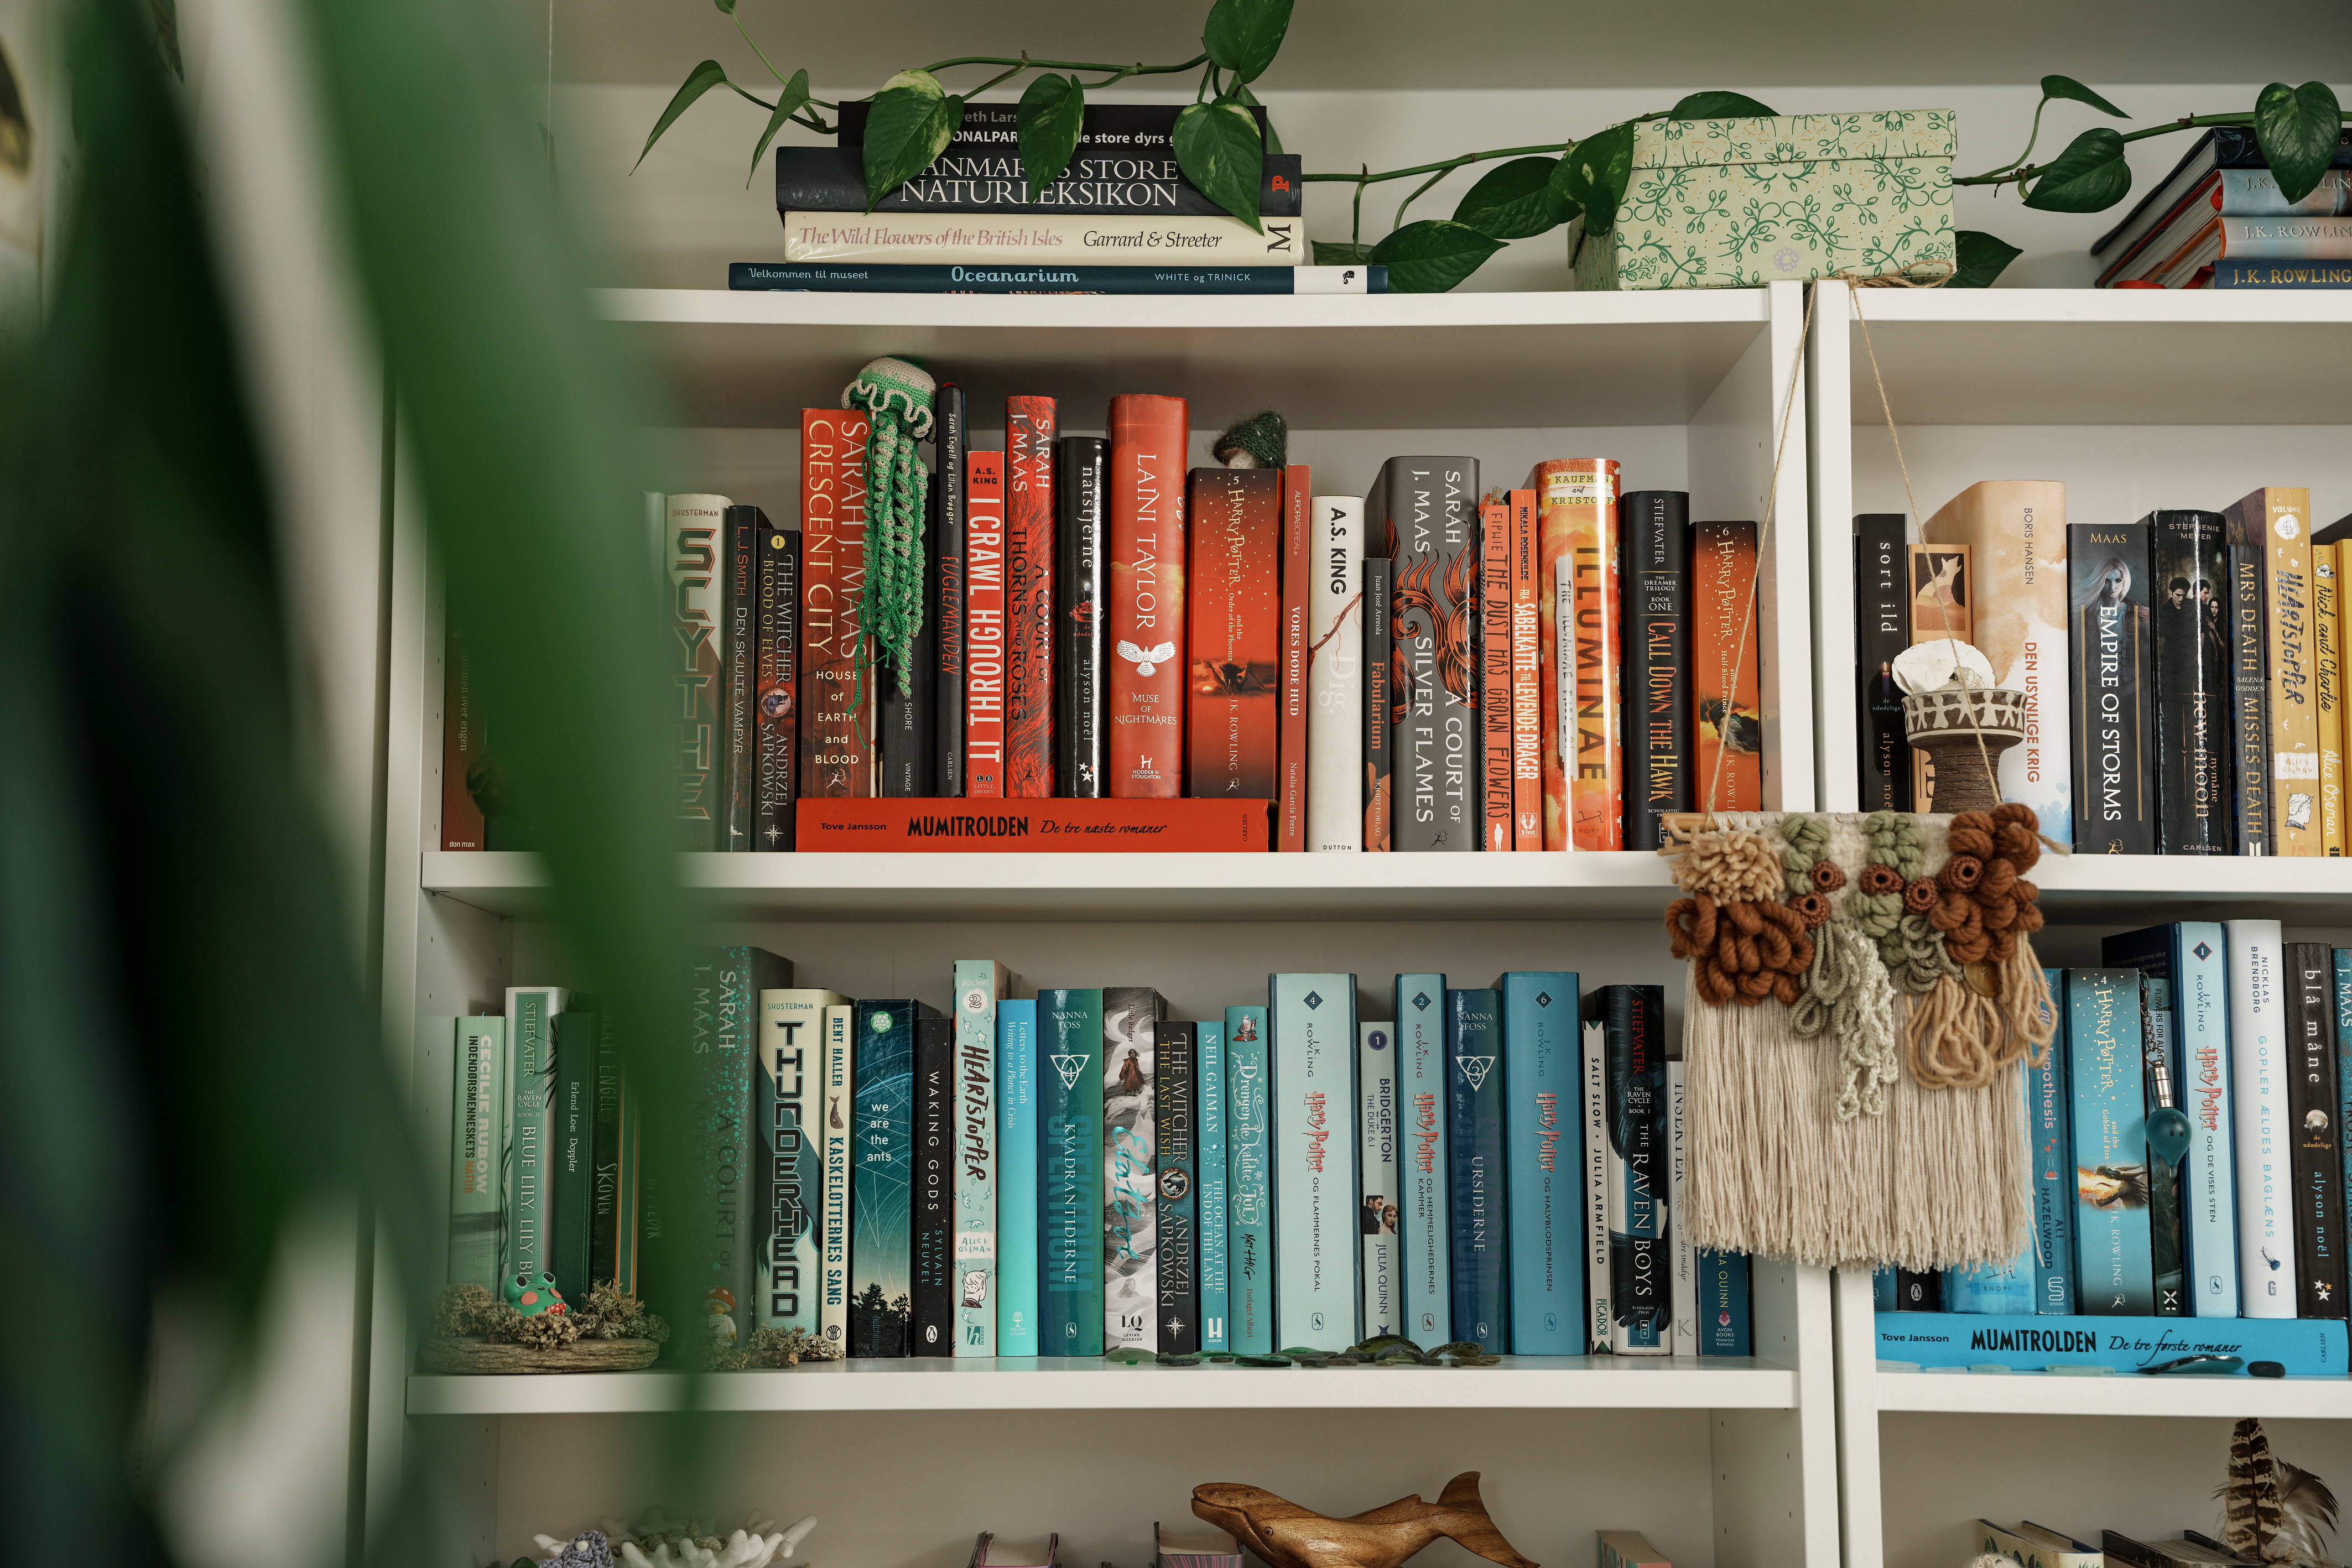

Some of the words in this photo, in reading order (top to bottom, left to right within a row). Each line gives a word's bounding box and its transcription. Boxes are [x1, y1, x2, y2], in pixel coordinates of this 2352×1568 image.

[1095, 133, 1130, 143] store
[1135, 132, 1164, 146] dyrs
[1080, 160, 1178, 180] STORE
[799, 227, 830, 244] The
[831, 228, 869, 244] Wild
[875, 228, 932, 246] Flowers
[935, 228, 951, 248] of
[953, 228, 974, 246] the
[977, 229, 1027, 246] British
[1031, 230, 1062, 246] Isles
[1084, 231, 1143, 248] Garrard
[1147, 231, 1162, 247] &
[1165, 231, 1222, 247] Streeter
[748, 267, 812, 278] Velkommen
[815, 269, 826, 278] til
[830, 270, 868, 279] museet
[951, 266, 1079, 283] Oceanarium
[1194, 275, 1205, 283] og
[2233, 269, 2265, 285] J.K.
[2270, 269, 2351, 284] ROWLING
[947, 413, 956, 434] Sarah
[945, 436, 956, 459] Engell
[946, 462, 955, 471] og
[947, 473, 956, 492] Lilian
[807, 420, 834, 576] CRESCENT
[1136, 453, 1159, 523] LAINI
[945, 494, 955, 525] Brøgger
[1330, 507, 1347, 542] A.S.
[2023, 507, 2033, 538] BORIS
[736, 540, 748, 551] J.
[737, 526, 748, 539] L.
[1653, 498, 1665, 565] STIEFVATER
[2090, 533, 2127, 543] MAAS
[969, 515, 1001, 596] CRAWL
[1011, 527, 1028, 616] THORNS
[1035, 564, 1049, 581] A
[1330, 548, 1347, 595] KING
[1486, 555, 1508, 589] THE
[1879, 543, 1895, 589] sort
[2024, 541, 2034, 585] HANSEN
[736, 555, 747, 596] SMITH
[1131, 533, 1157, 631] TAYLOR
[1374, 575, 1382, 592] Juan
[2240, 562, 2255, 602] MRS
[1375, 593, 1383, 608] José
[1519, 590, 1529, 600] FRA
[736, 607, 747, 635] DEN
[807, 581, 834, 655] CITY
[941, 555, 960, 675] FUGLEMANDEN
[1034, 589, 1050, 664] COURT
[1289, 606, 1301, 647] VORES
[1486, 600, 1508, 639] DUST
[1880, 603, 1897, 632] ild
[1015, 620, 1024, 646] AND
[1513, 603, 1537, 671] SABELKATTE
[1648, 622, 1676, 660] CALL
[2099, 605, 2118, 687] EMPIRE
[2241, 609, 2257, 671] DEATH
[735, 641, 746, 696] SKJULTE
[970, 608, 1002, 726] THROUGH
[1288, 649, 1302, 686] DØDE
[1487, 649, 1508, 675] HAS
[2025, 642, 2037, 670] DEN
[1011, 650, 1028, 721] ROSES
[1038, 668, 1049, 684] OF
[1414, 636, 1433, 716] SILVER
[1520, 673, 1529, 681] TIL
[1648, 666, 1677, 713] DOWN
[1132, 692, 1160, 704] MUSE
[1289, 689, 1300, 717] HUD
[1370, 660, 1386, 751] Fabularium
[1445, 692, 1461, 708] A
[1487, 688, 1508, 733] GROWN
[1514, 682, 1538, 731] LEVENDE
[2025, 676, 2039, 744] USYNLIGE
[2101, 693, 2119, 723] OF
[733, 701, 745, 754] VAMPYR
[1115, 715, 1177, 725] NIGHTMARES
[1648, 720, 1674, 749] THE
[2243, 697, 2260, 764] MISSES
[969, 741, 1001, 763] IT
[1445, 717, 1463, 801] COURT
[1516, 733, 1539, 779] DRAGER
[2027, 748, 2039, 783] KRIG
[1289, 762, 1298, 789] Natalia
[1415, 727, 1433, 823] FLAMES
[1487, 747, 1509, 819] FLOWERS
[1648, 754, 1679, 802] HAWK
[2101, 729, 2121, 821] STORMS
[1287, 790, 1298, 814] García
[1450, 806, 1460, 824] OF
[2246, 771, 2262, 835] DEATH
[847, 822, 887, 831] Jansson
[907, 816, 1029, 837] MUMITROLDEN
[1288, 815, 1297, 837] Freire
[2251, 946, 2261, 1014] BRENDBORG
[2261, 957, 2270, 1003] NICKLAS
[832, 1017, 844, 1045] BENT
[831, 1048, 843, 1087] HALLER
[1205, 1034, 1216, 1069] NEIL
[1591, 1058, 1600, 1090] SALT
[570, 1081, 579, 1111] Erlend
[928, 1071, 939, 1147] WAKING
[1205, 1072, 1217, 1134] GAIMAN
[1592, 1093, 1601, 1128] SLOW
[569, 1114, 578, 1132] Loe:
[1378, 1078, 1392, 1162] BRIDGERTON
[1640, 1124, 1650, 1147] THE
[567, 1138, 577, 1173] Doppler
[2207, 1135, 2214, 1152] OG
[1593, 1148, 1604, 1187] JULIA
[2208, 1155, 2215, 1169] DE
[828, 1137, 844, 1262] KASKELOTTERNES
[928, 1160, 939, 1211] GODS
[1203, 1183, 1213, 1207] END
[1213, 1179, 1223, 1203] THE
[1313, 1178, 1319, 1190] OG
[1632, 1153, 1651, 1230] RAVEN
[1063, 1123, 1076, 1284] KVADRANTIDERNE
[1204, 1211, 1213, 1227] OF
[1471, 1155, 1485, 1252] URSIDERNE
[2209, 1197, 2217, 1223] STEN
[1204, 1231, 1214, 1254] THE
[1213, 1207, 1224, 1247] OCEAN
[1594, 1194, 1605, 1264] ARMFIELD
[2041, 1187, 2053, 1269] HAZELWOOD
[2055, 1219, 2064, 1238] ALI
[921, 1232, 929, 1284] NEUVEL
[934, 1230, 943, 1286] SYLVAIN
[1204, 1259, 1214, 1290] LANE
[1214, 1251, 1224, 1267] AT
[1375, 1244, 1388, 1273] JULIA
[1634, 1240, 1652, 1296] BOYS
[826, 1269, 842, 1305] SANG
[1214, 1270, 1225, 1294] THE
[1377, 1276, 1388, 1315] QUINN
[1971, 1329, 2096, 1353] MUMITROLDEN
